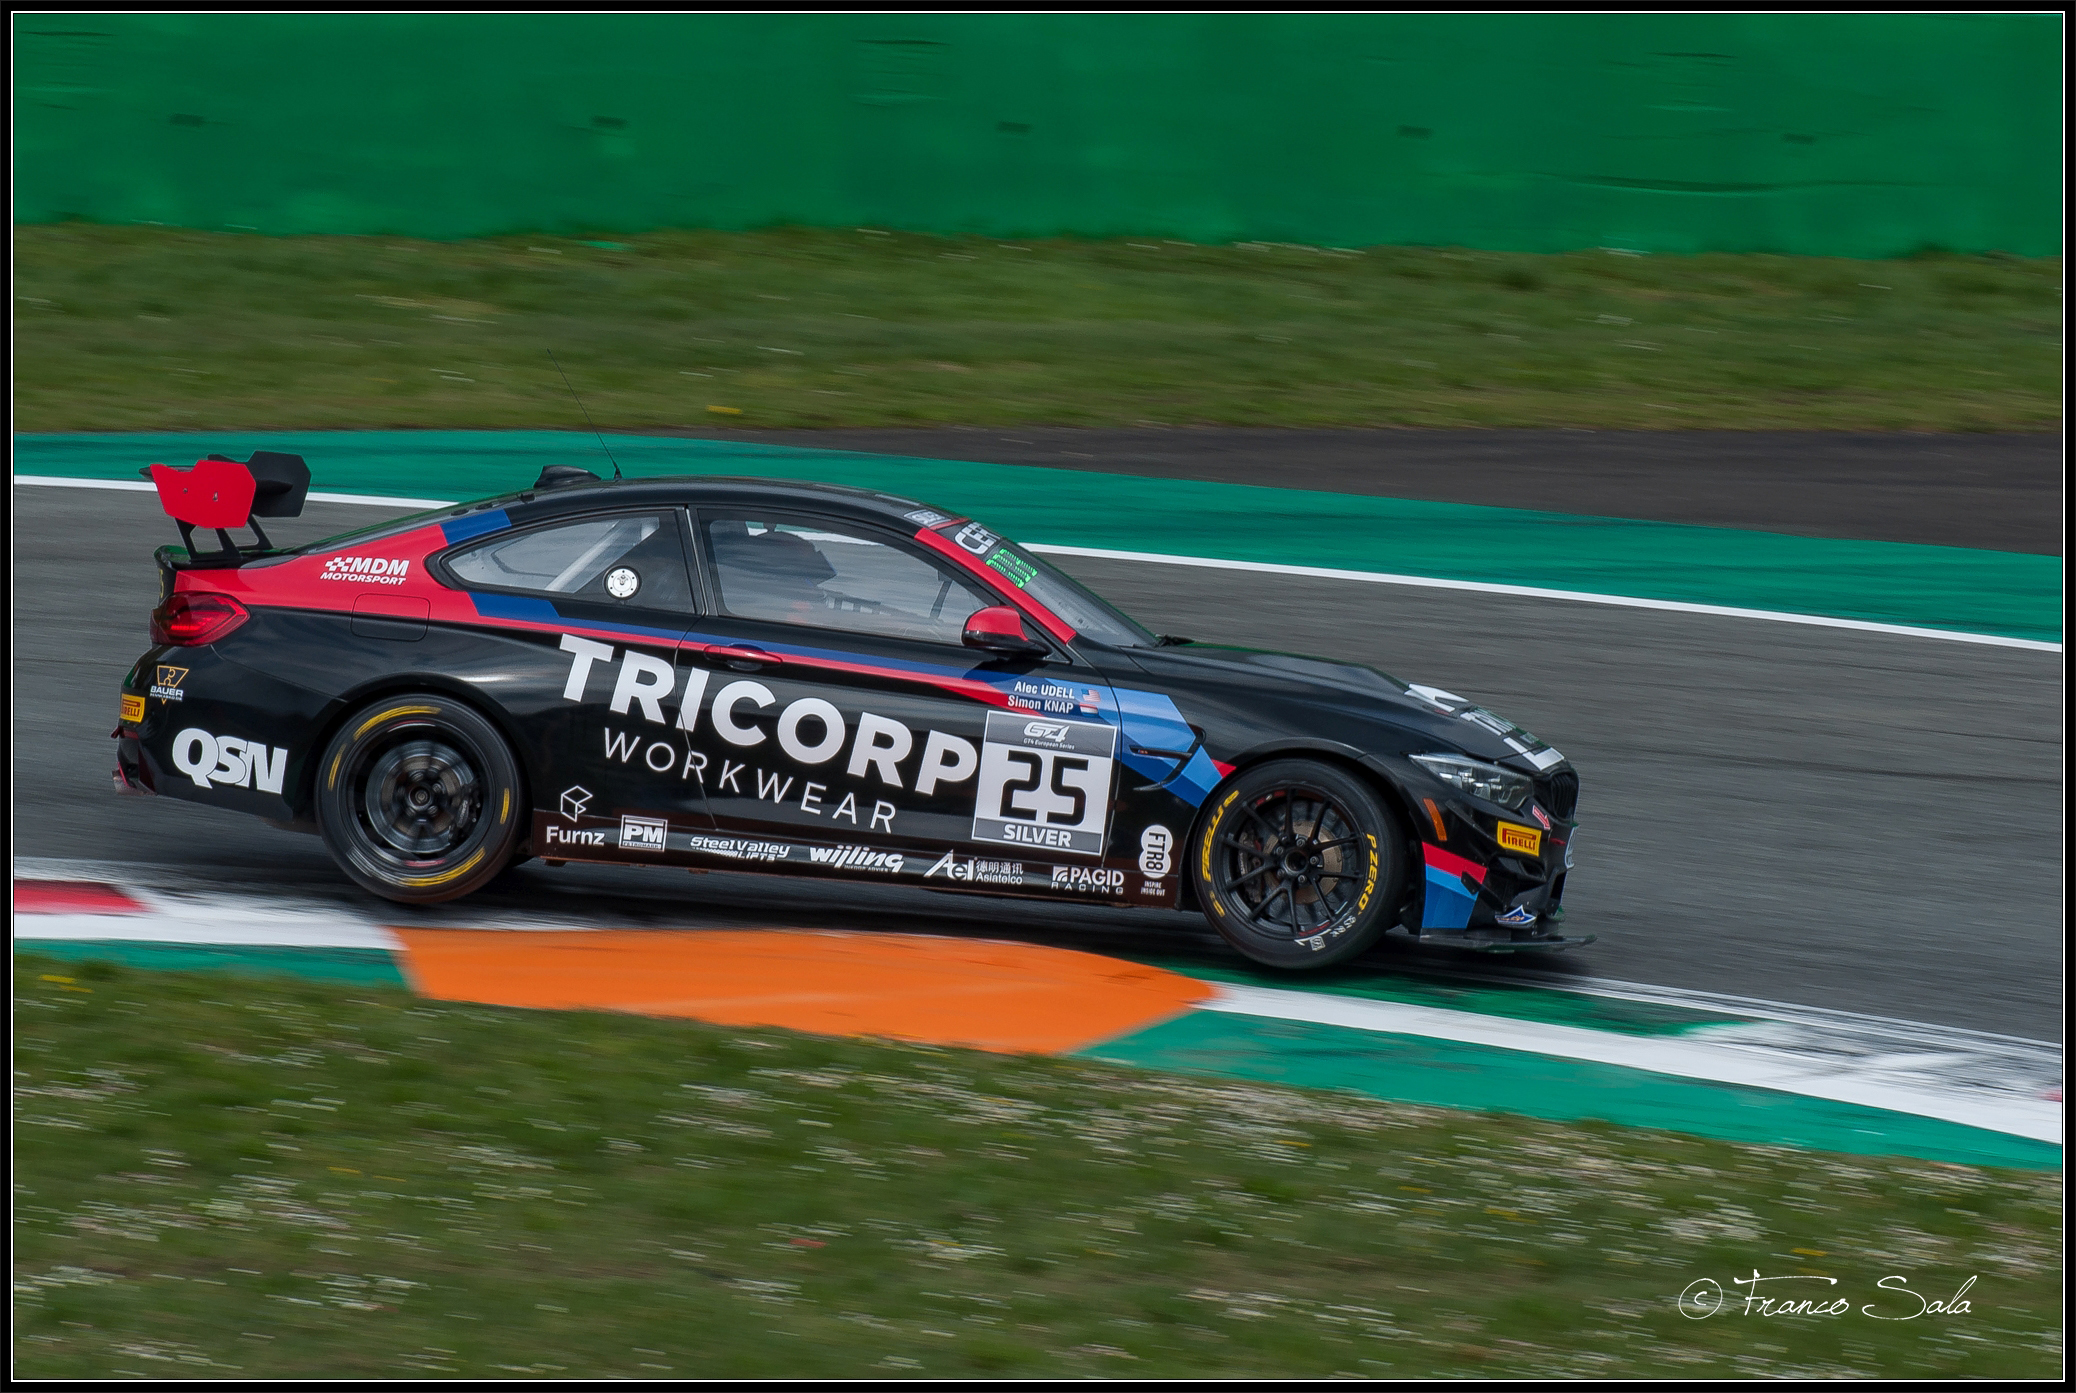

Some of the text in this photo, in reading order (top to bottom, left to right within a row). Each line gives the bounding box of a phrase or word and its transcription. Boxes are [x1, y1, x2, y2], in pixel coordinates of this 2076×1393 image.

[349, 557, 410, 576] MDM
[320, 571, 407, 585] MOTORSPORT
[150, 685, 184, 698] BAUER
[1014, 681, 1075, 699] Alec UDELL
[1007, 695, 1074, 714] Simon KNAP
[559, 633, 978, 796] TRICORP
[1023, 721, 1070, 742] GT4
[1034, 739, 1059, 749] European
[1059, 742, 1075, 750] Series
[172, 727, 288, 795] QSN
[604, 727, 896, 834] WORKWEAR
[999, 749, 1089, 826] 25
[546, 825, 605, 846] Furnz
[623, 824, 663, 843] PM
[1003, 823, 1072, 848] SILVER
[1502, 827, 1537, 851] PIRELLI
[737, 851, 776, 861] LIFTS
[1146, 832, 1166, 871] FTR8
[976, 860, 1024, 875] 德明通讯
[1070, 867, 1125, 886] PAGID
[976, 872, 1023, 885] Asiatelco
[1051, 882, 1124, 895] RACING
